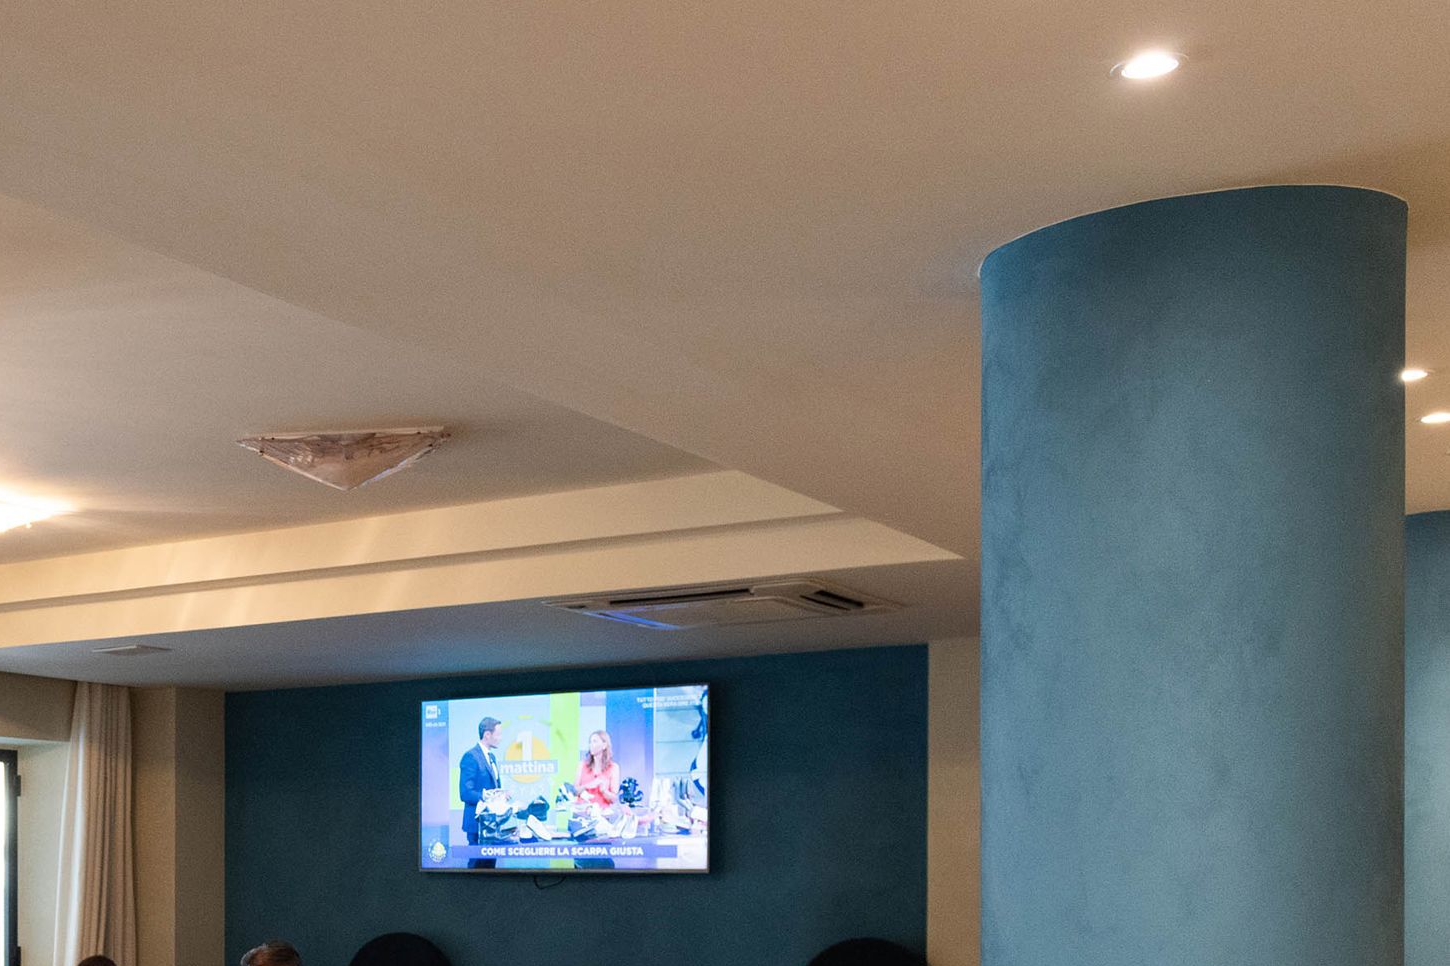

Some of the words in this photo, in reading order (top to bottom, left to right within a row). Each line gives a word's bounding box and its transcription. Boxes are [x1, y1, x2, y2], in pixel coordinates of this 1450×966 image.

[499, 761, 553, 773] mattina
[481, 847, 506, 856] COME
[508, 847, 556, 856] SCEGLIERE
[557, 847, 569, 856] LA
[571, 847, 607, 855] SCARPA
[610, 847, 644, 855] GIUSTA
